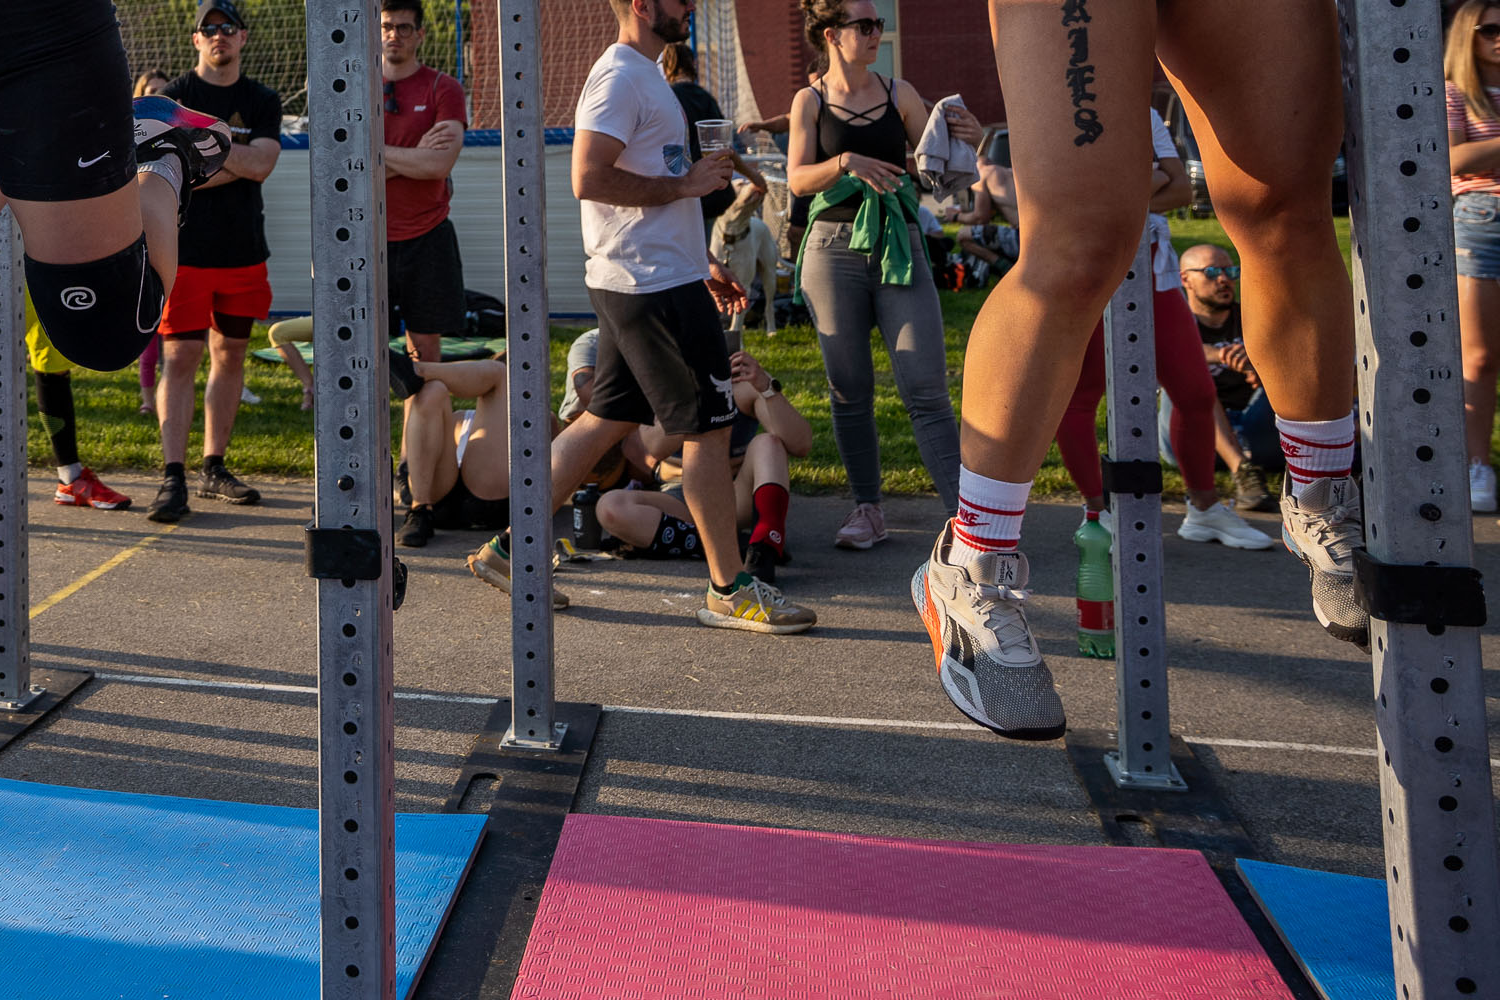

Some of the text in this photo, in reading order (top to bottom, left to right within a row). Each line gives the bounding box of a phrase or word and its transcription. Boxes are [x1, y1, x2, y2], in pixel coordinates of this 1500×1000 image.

[342, 10, 360, 23] 17
[1409, 81, 1433, 97] 15
[344, 108, 363, 122] 15
[1412, 138, 1437, 153] 14
[345, 159, 364, 172] 14
[1418, 195, 1439, 210] 13
[347, 208, 364, 221] 13
[348, 257, 366, 271] 12
[1419, 252, 1443, 267] 12
[347, 307, 366, 320] 11
[1422, 309, 1446, 323] 11
[349, 356, 368, 370] 10
[1425, 367, 1451, 381] 10
[1434, 539, 1446, 553] 7
